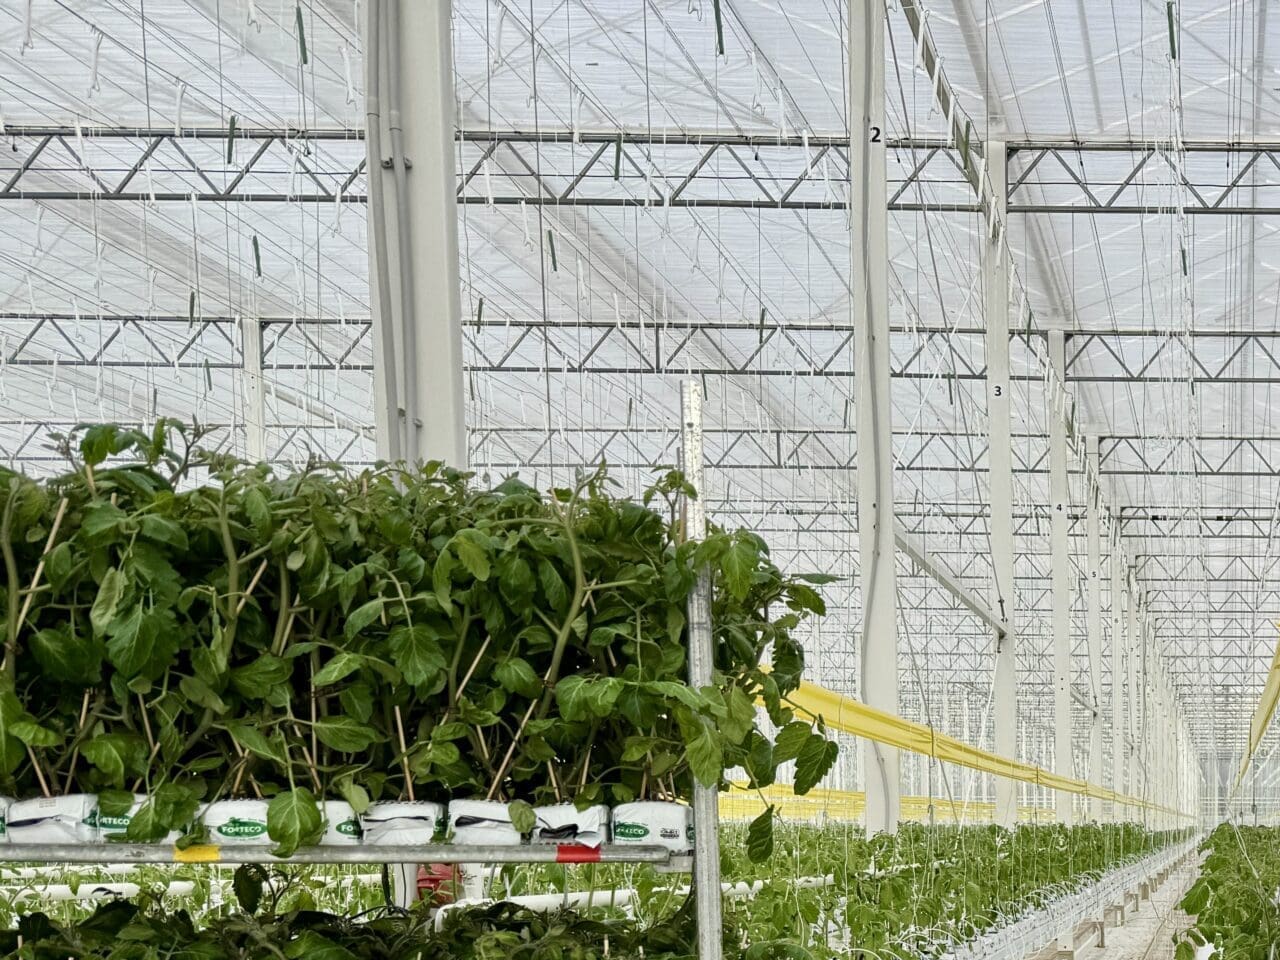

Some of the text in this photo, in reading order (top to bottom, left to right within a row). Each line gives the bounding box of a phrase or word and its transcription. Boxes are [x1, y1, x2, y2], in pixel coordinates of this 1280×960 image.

[870, 127, 881, 143] 2
[994, 385, 1002, 397] 3
[1056, 503, 1062, 512] 4
